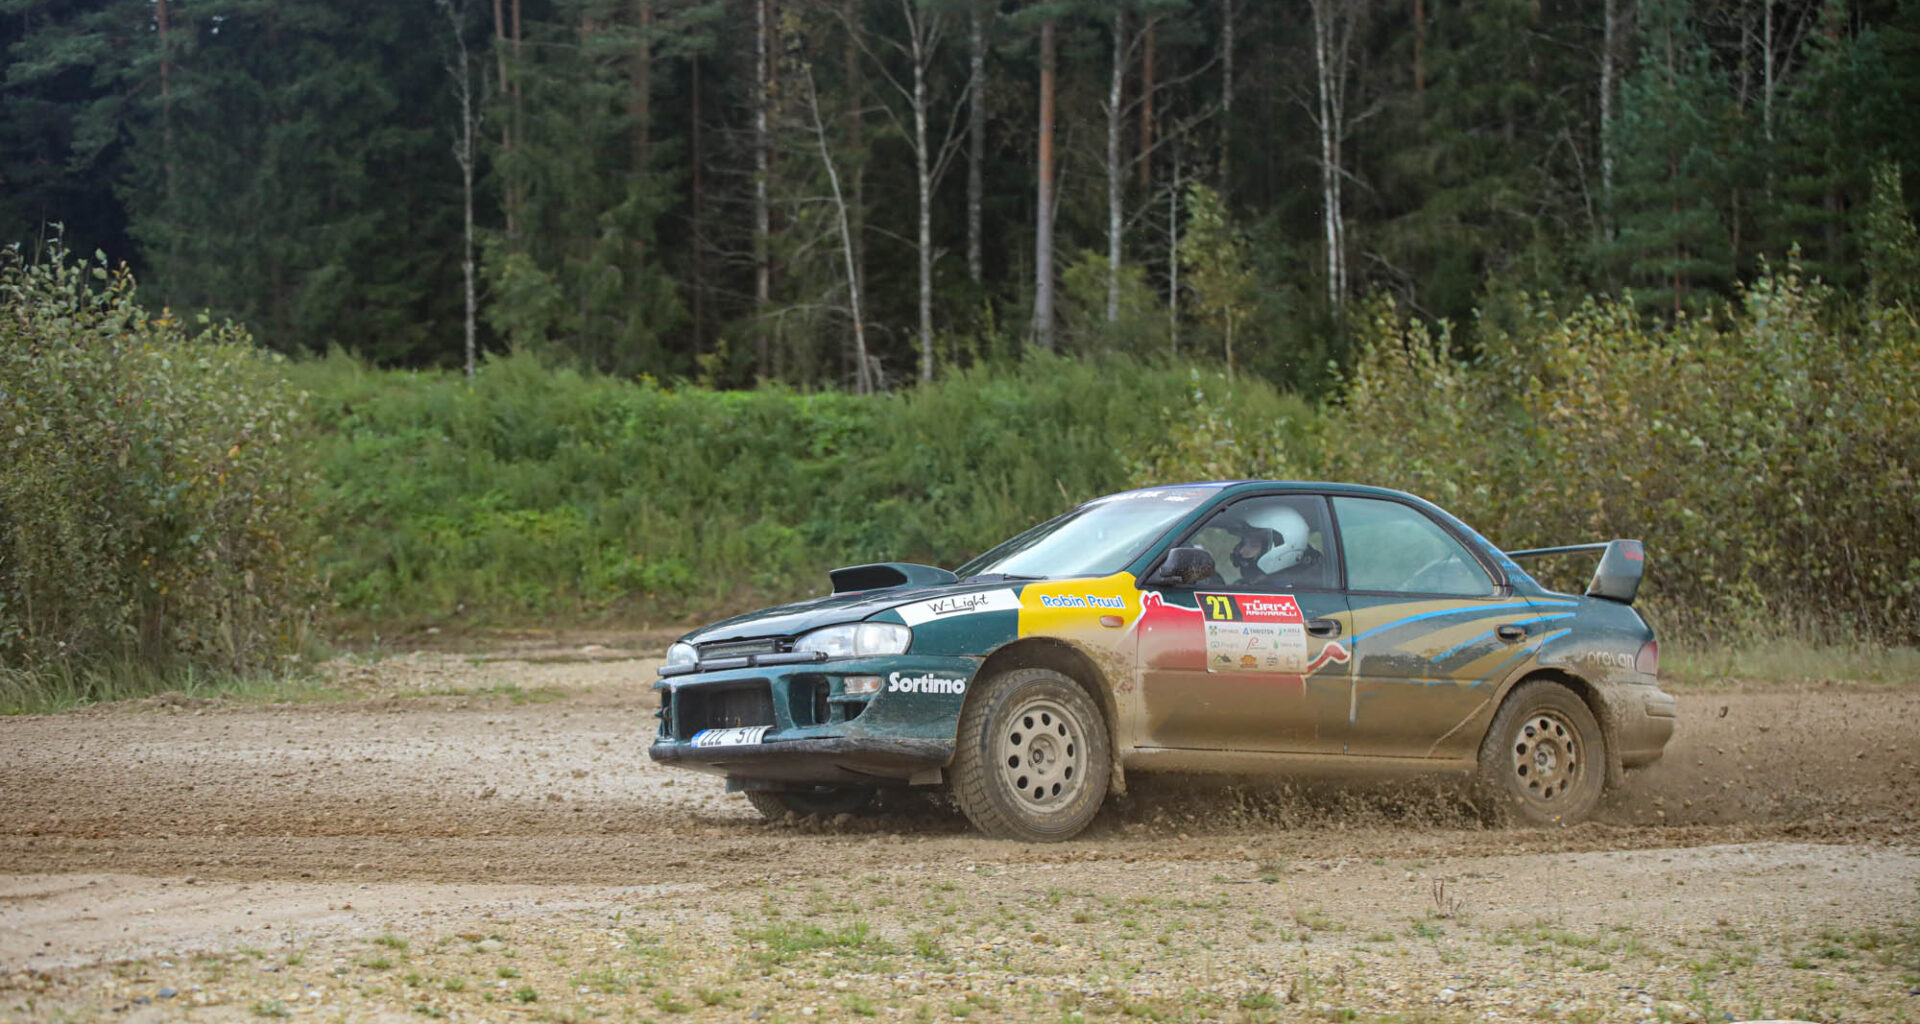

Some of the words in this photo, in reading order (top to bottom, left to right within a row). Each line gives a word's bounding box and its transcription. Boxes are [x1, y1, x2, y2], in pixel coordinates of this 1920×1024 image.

[928, 594, 989, 612] W-Light
[1041, 595, 1085, 607] Robin
[1088, 595, 1126, 609] Pruul
[1206, 595, 1233, 620] 27
[888, 671, 966, 694] Sortimo
